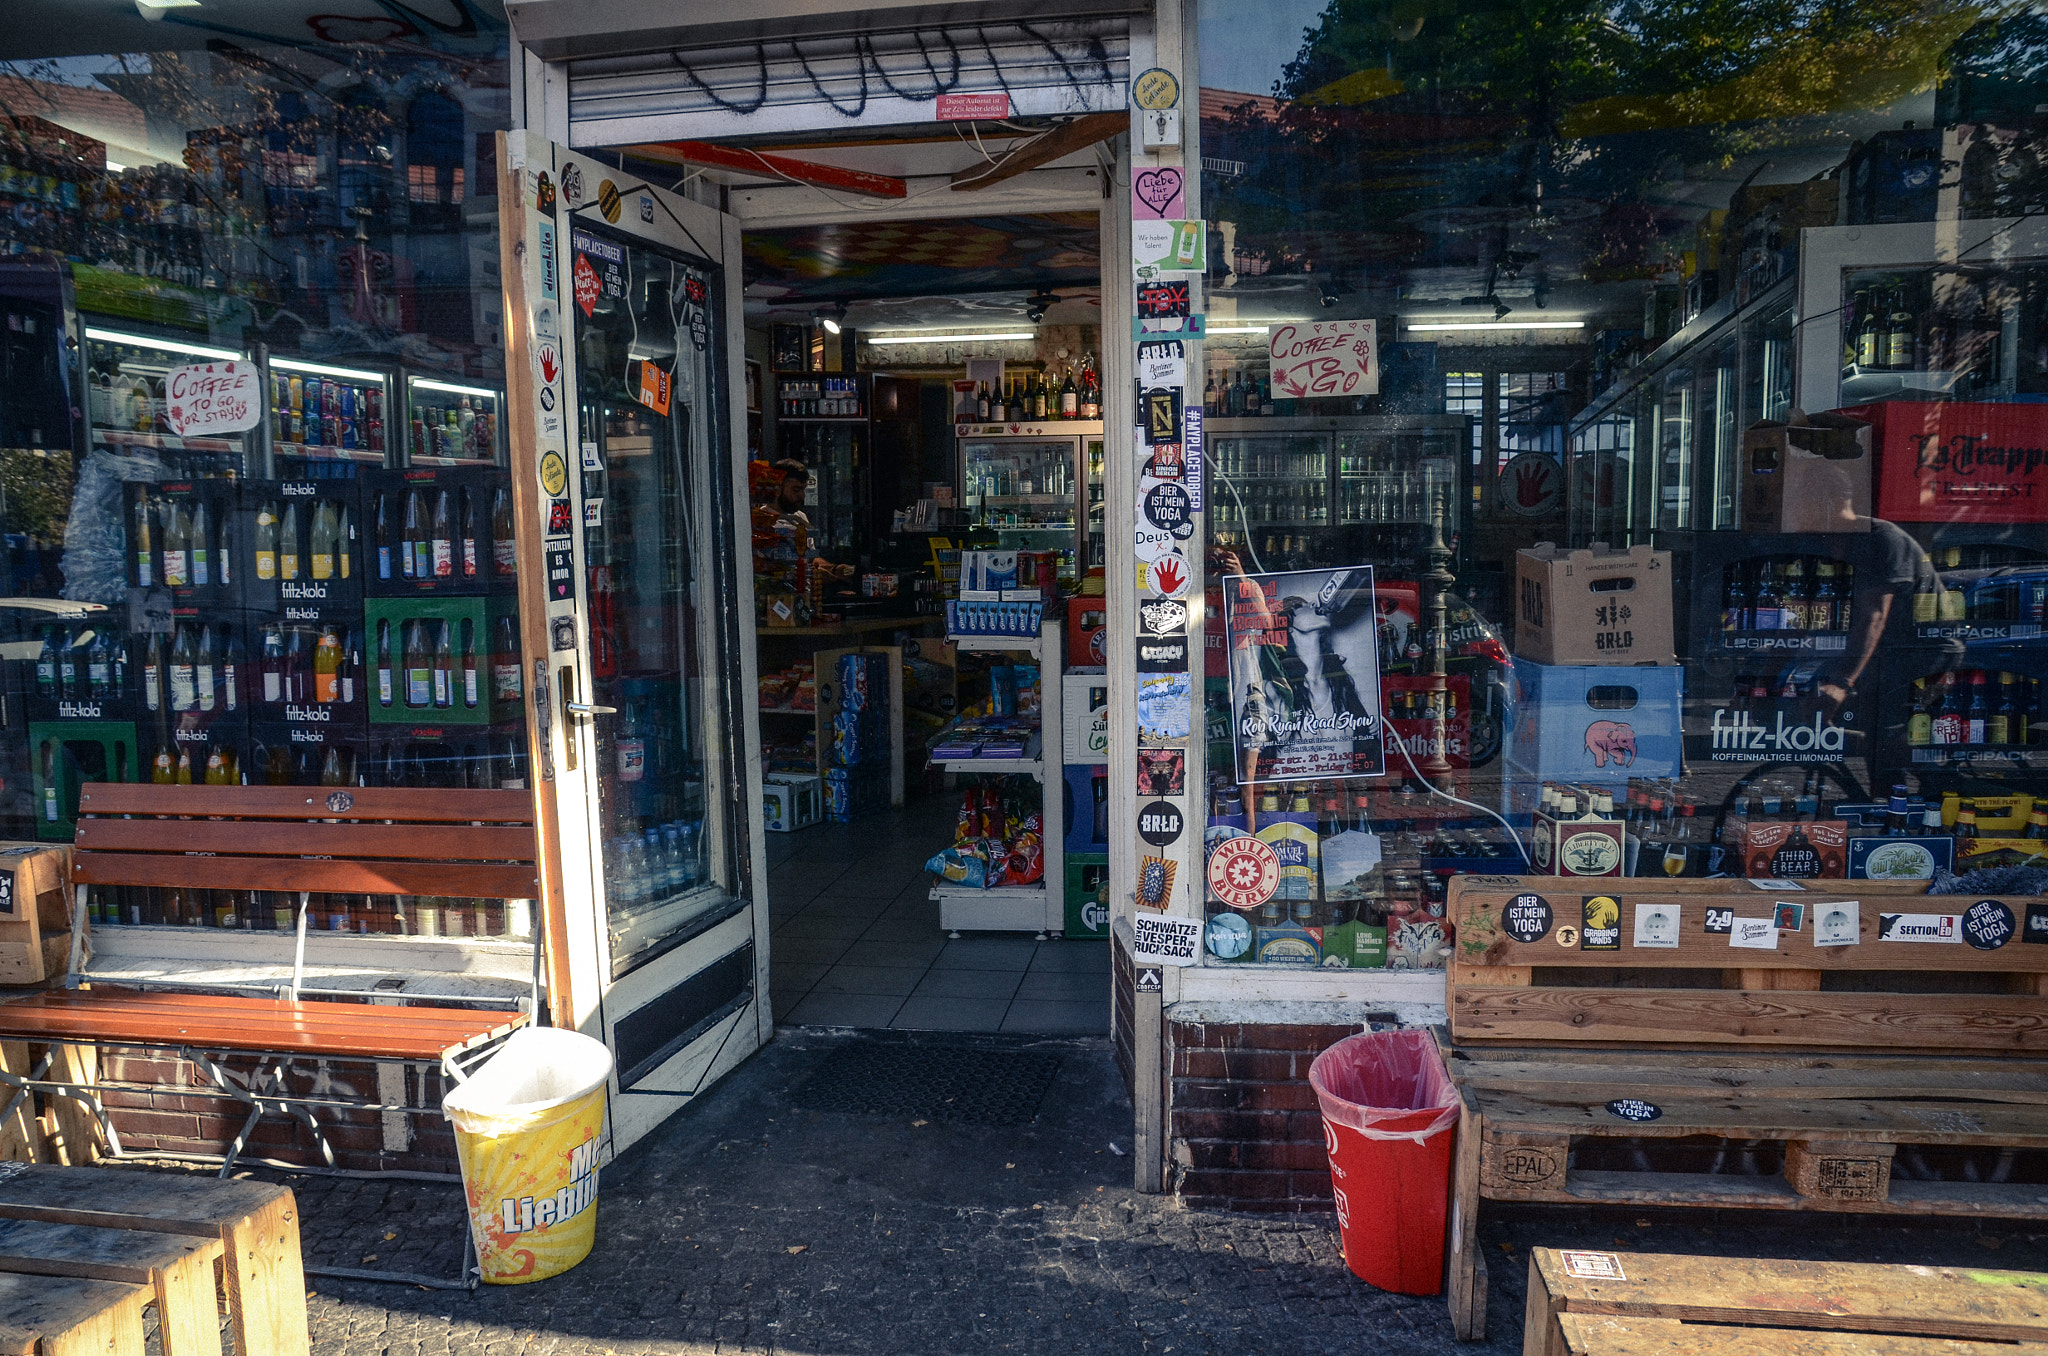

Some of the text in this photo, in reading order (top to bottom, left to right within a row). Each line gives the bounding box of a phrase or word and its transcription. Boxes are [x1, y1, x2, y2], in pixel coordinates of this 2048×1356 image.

[1144, 175, 1174, 188] Liebe
[1152, 186, 1167, 194] für
[1148, 194, 1169, 203] ALLE
[573, 233, 621, 262] #MYPLACETOBEER
[1142, 286, 1186, 312] TOY
[1271, 326, 1355, 359] COFFEE
[1289, 357, 1341, 378] TO
[1152, 369, 1175, 381] Sommer
[172, 373, 249, 399] COFFEE
[1311, 370, 1359, 394] GO
[190, 395, 235, 410] TO GO
[184, 407, 236, 425] OR STAY
[1186, 409, 1201, 509] #MYPLACETOBEER
[282, 483, 316, 496] fritz-kola
[1159, 486, 1178, 496] BIER
[1929, 481, 2038, 498] TRAPPIST
[1151, 496, 1185, 508] IST MEIN
[1154, 507, 1181, 520] YOGA
[1135, 532, 1170, 545] Deus
[555, 555, 563, 565] ES
[1585, 564, 1608, 572] HANDLE
[1608, 563, 1623, 571] WITH
[552, 569, 570, 581] AMOR
[282, 582, 328, 599] fritz-kola
[286, 608, 320, 620] fritz-kola
[1917, 626, 2009, 639] LOGIPACK
[1725, 637, 1813, 649] LOGIPACK
[59, 702, 103, 717] fritz-kola
[286, 705, 332, 721] fritz-kola
[1242, 717, 1267, 737] Rob
[1268, 714, 1302, 736] Ryan
[1303, 712, 1337, 734] Road
[1338, 711, 1374, 731] Show
[1710, 708, 1845, 750] fritz-kola
[176, 729, 209, 741] fritz-kola
[291, 730, 325, 742] fritz-kola
[1385, 732, 1462, 757] Rothaus
[1308, 754, 1319, 762] 20
[1712, 753, 1843, 762] KOFFEINHALTIGE LIMONADE
[1315, 763, 1346, 773] Friday
[1346, 762, 1363, 770] Oct
[1363, 761, 1375, 769] 07
[1218, 840, 1276, 867] WULLE
[1778, 850, 1813, 861] THIRD
[1780, 861, 1811, 872] BEAR
[1213, 878, 1270, 904] BIERE
[1517, 896, 1538, 907] BIER
[1509, 907, 1546, 919] IST MEIN
[1969, 902, 1992, 919] BIER
[1513, 918, 1543, 933] YOGA
[1966, 908, 2005, 933] IST MEIN
[1136, 919, 1191, 936] SCHWÄTZ
[1584, 928, 1618, 938] GRABBING
[1740, 923, 1767, 933] Berliner
[1899, 925, 1938, 936] SEKTION
[1975, 923, 2009, 943] YOGA
[1143, 931, 1188, 947] VESPER
[1742, 931, 1768, 940] Sommer
[1135, 941, 1194, 958] RUCKSACK
[1617, 1107, 1652, 1118] YOGA
[1630, 1104, 1654, 1112] MEIN
[1504, 1155, 1548, 1177] EPAL
